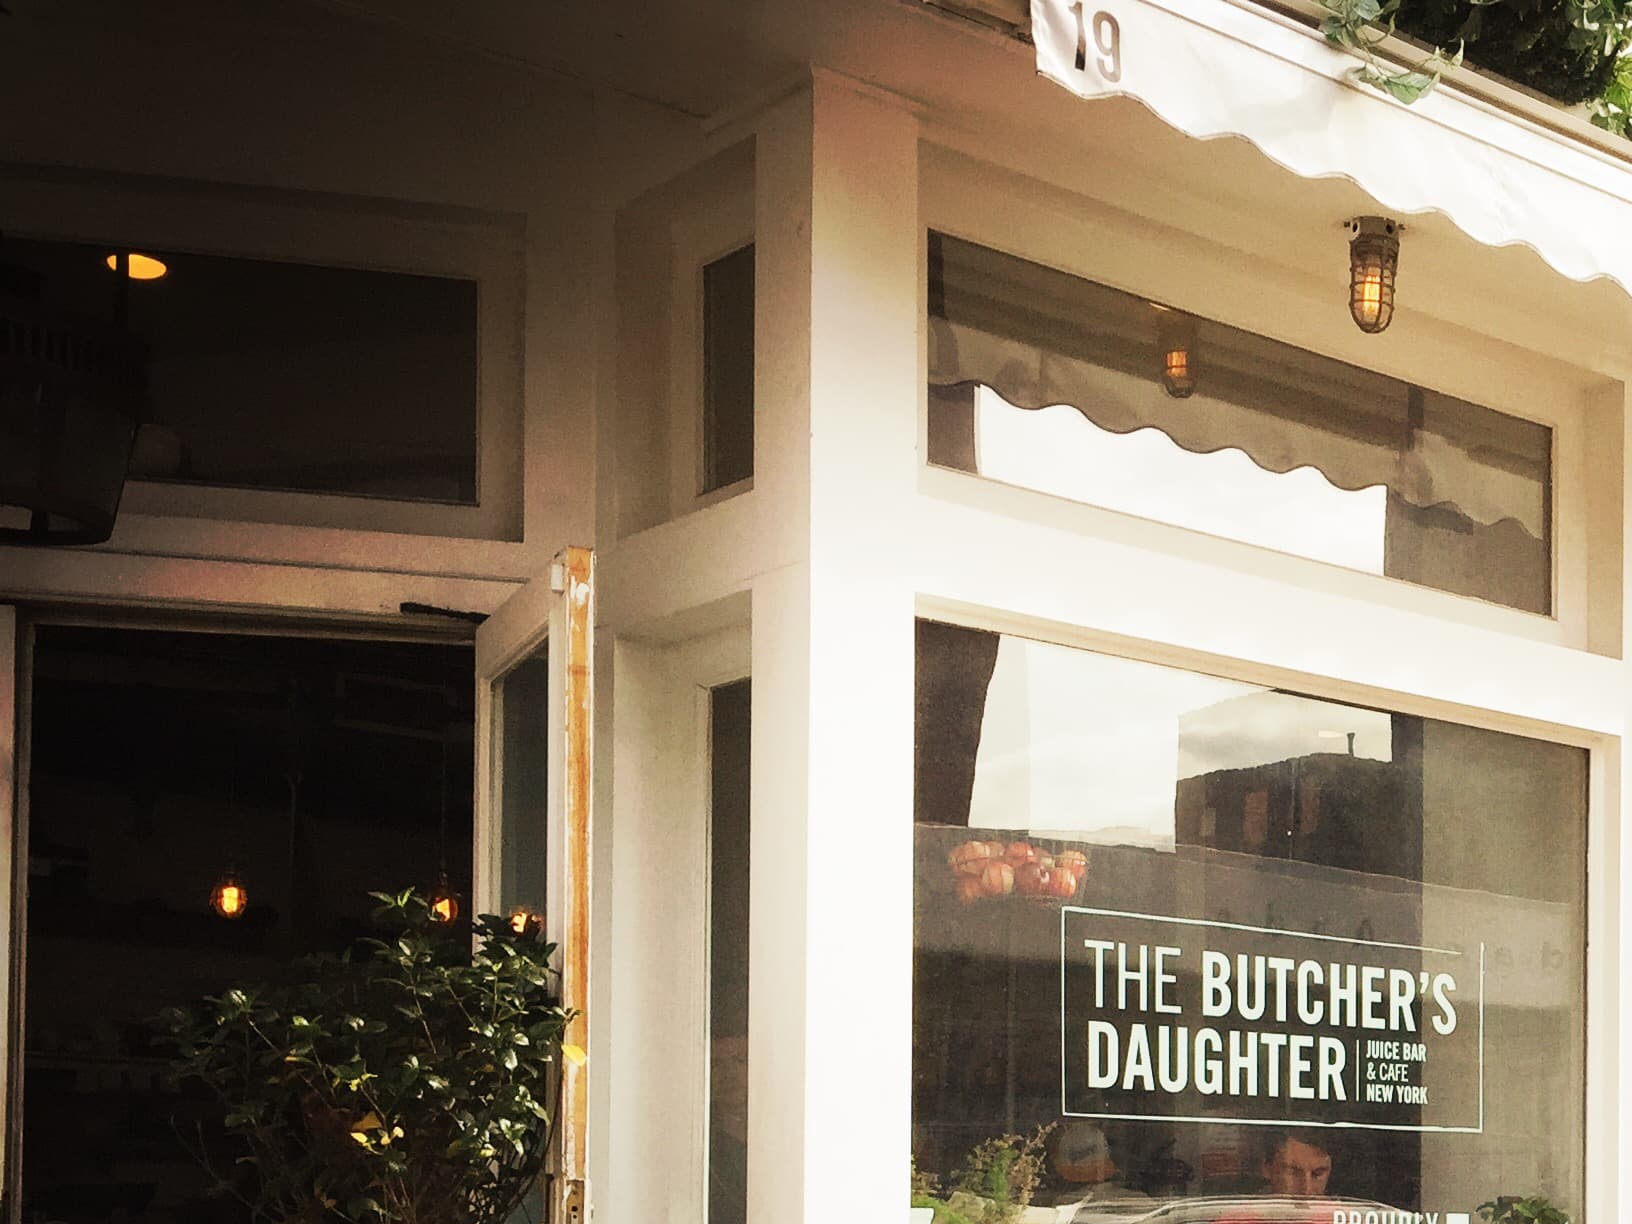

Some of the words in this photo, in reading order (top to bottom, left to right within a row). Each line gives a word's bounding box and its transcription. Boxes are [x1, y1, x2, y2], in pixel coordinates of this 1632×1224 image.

[1069, 2, 1121, 83] 19
[1084, 939, 1182, 1014] THE
[1202, 951, 1457, 1035] BUTCHER'S
[1088, 1020, 1347, 1101] DAUGHTER
[1366, 1040, 1400, 1060] JUICE
[1403, 1042, 1426, 1062] BAR
[1367, 1062, 1376, 1080] &
[1380, 1063, 1408, 1082] CAFE
[1367, 1084, 1393, 1103] NEW
[1396, 1086, 1428, 1104] YORK
